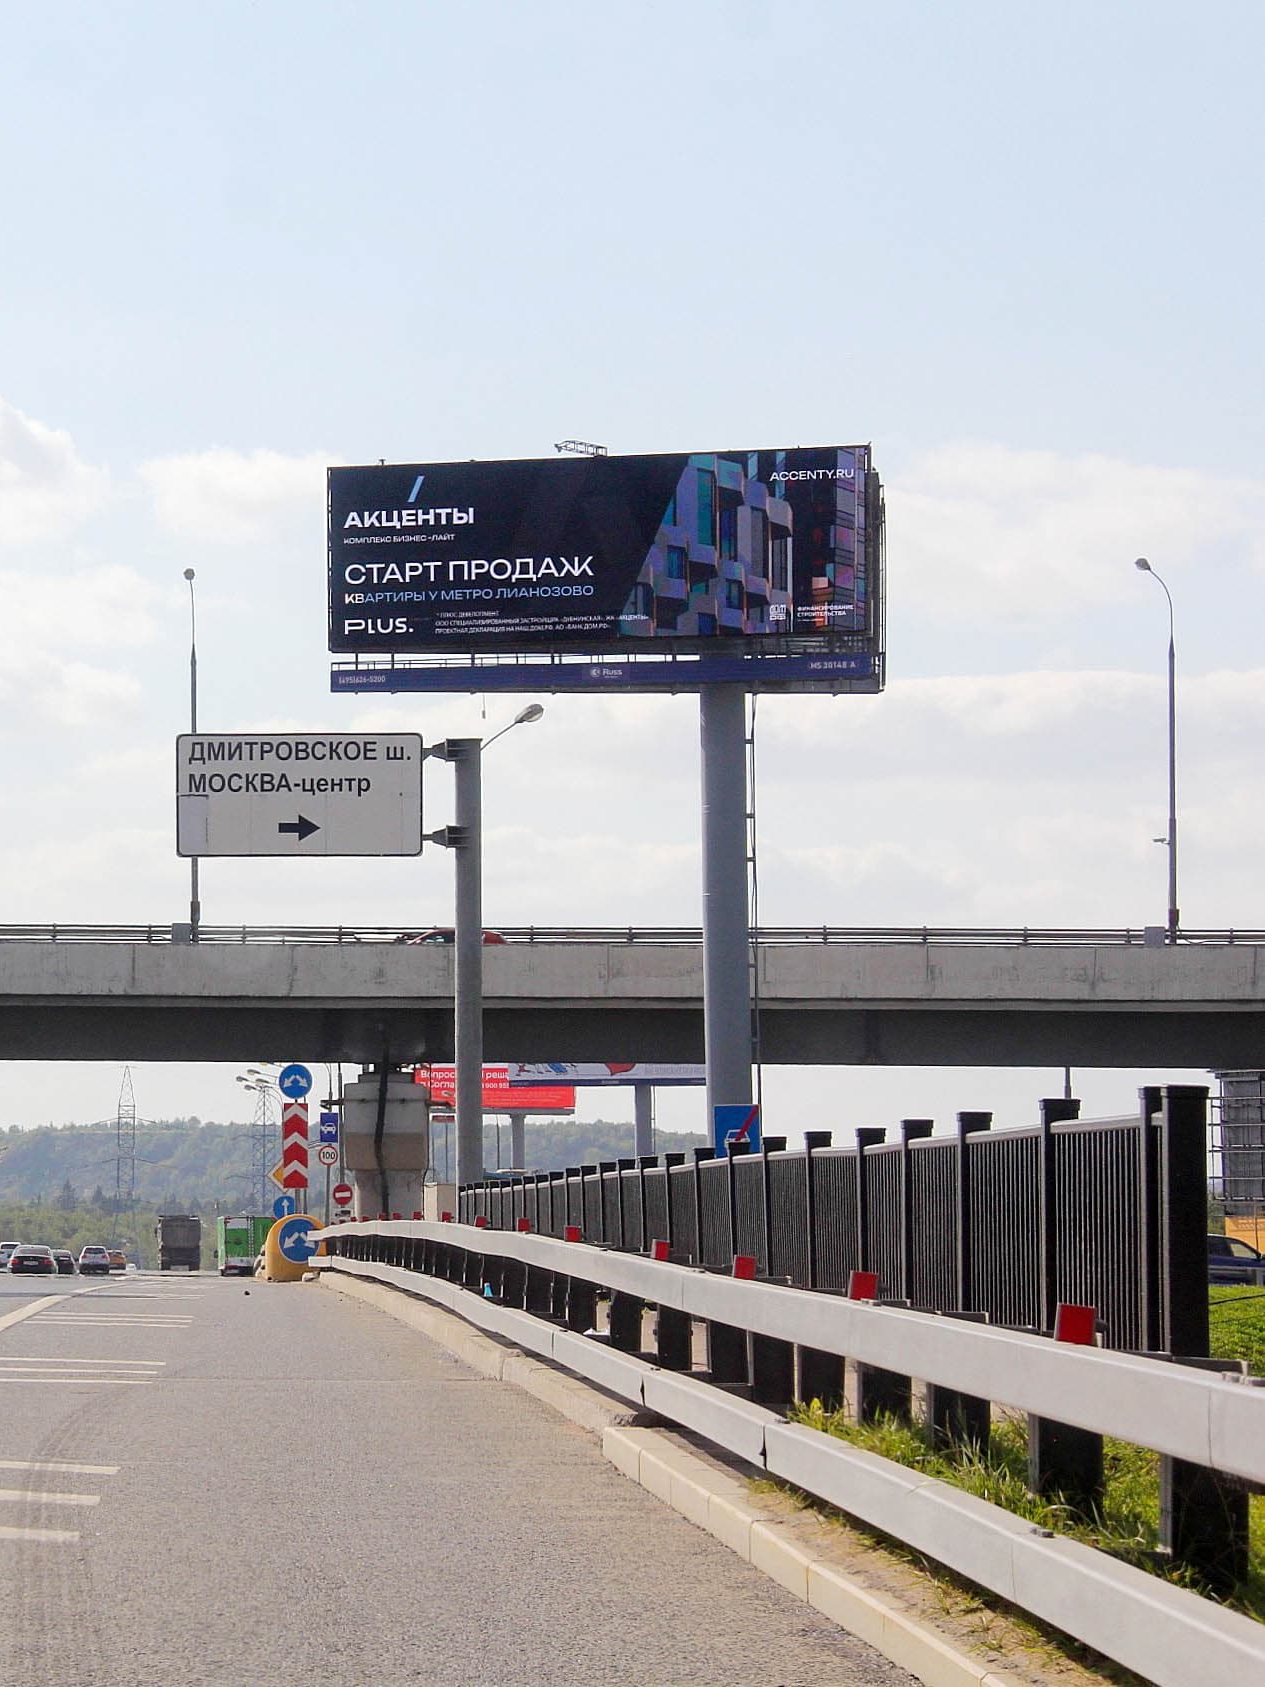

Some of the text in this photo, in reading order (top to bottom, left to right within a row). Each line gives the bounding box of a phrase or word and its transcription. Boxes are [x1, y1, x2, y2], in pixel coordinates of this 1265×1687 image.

[769, 469, 854, 482] ACCENTY.RU
[343, 507, 474, 529] АКЦЕНТЫ
[343, 535, 391, 544] КОМПЛЕКС
[344, 556, 594, 585] СТАРТ ПРОДАЖ
[344, 585, 594, 604] КВАРТИРЫ У МЕТРО ЛИАНОЗОВО
[344, 618, 414, 635] PLUS.
[602, 668, 623, 676] Russ
[188, 740, 412, 764] ДМИТРОВСКОЕ ш.
[188, 773, 371, 797] МОСКВА-центр
[322, 1151, 336, 1160] 100
